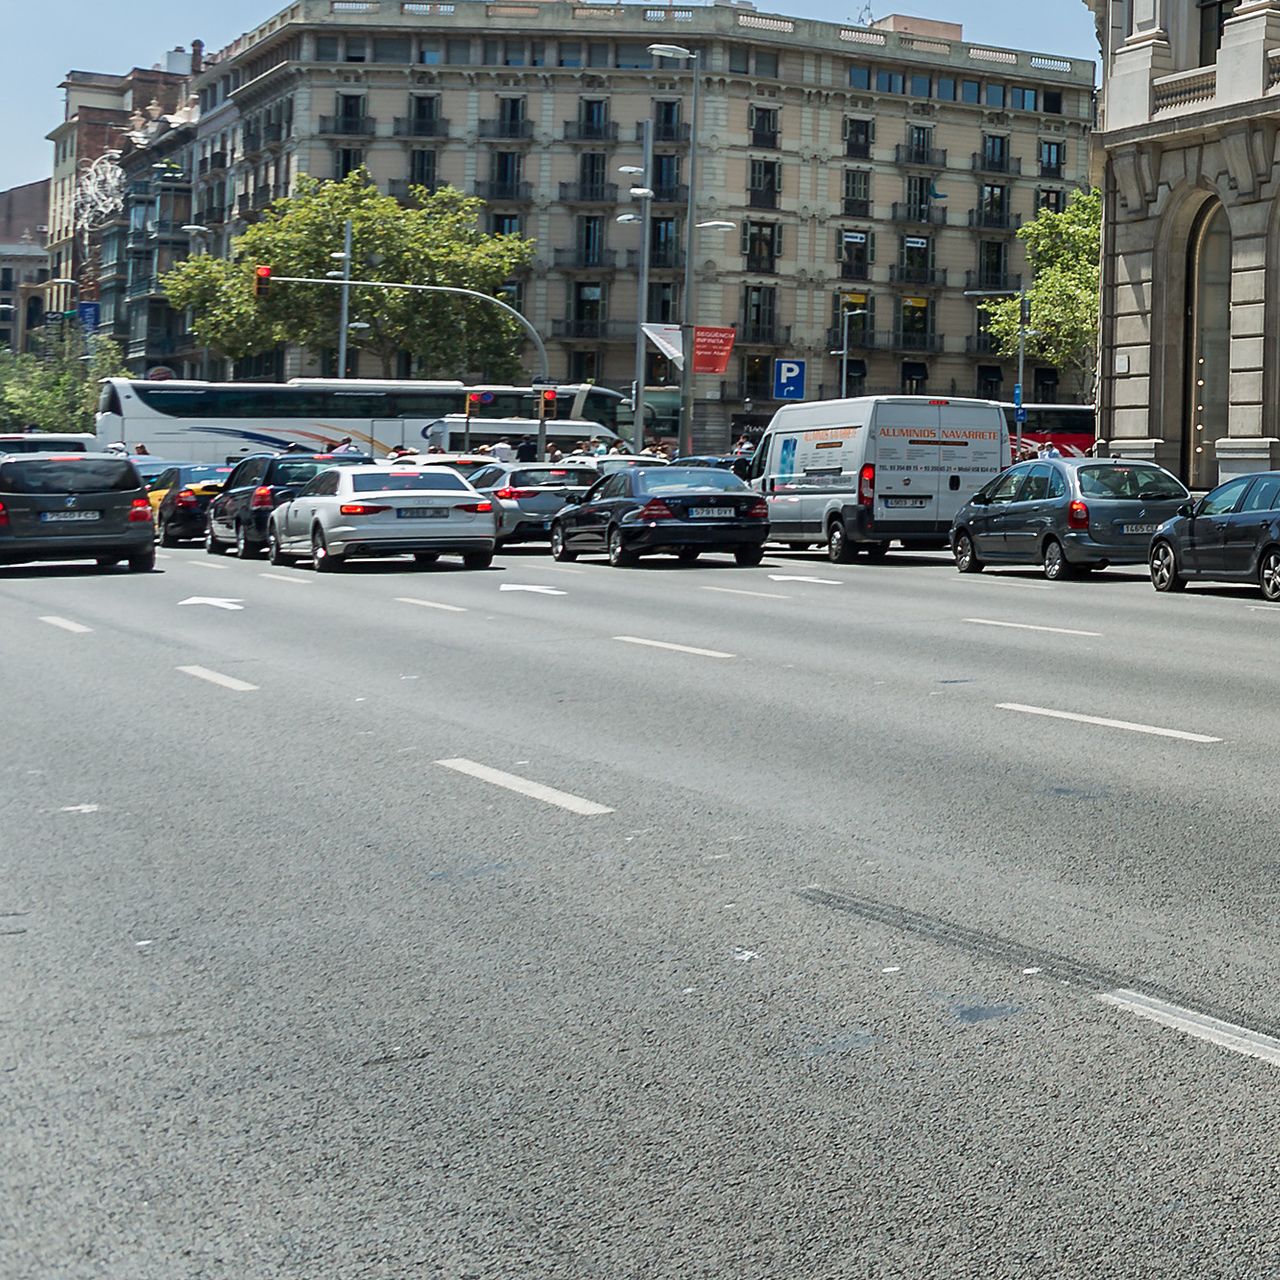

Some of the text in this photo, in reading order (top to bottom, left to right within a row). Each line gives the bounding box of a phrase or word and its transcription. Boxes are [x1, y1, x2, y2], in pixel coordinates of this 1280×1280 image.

[780, 362, 800, 384] P
[879, 427, 999, 440] ALUMINIOS NAVARRETE
